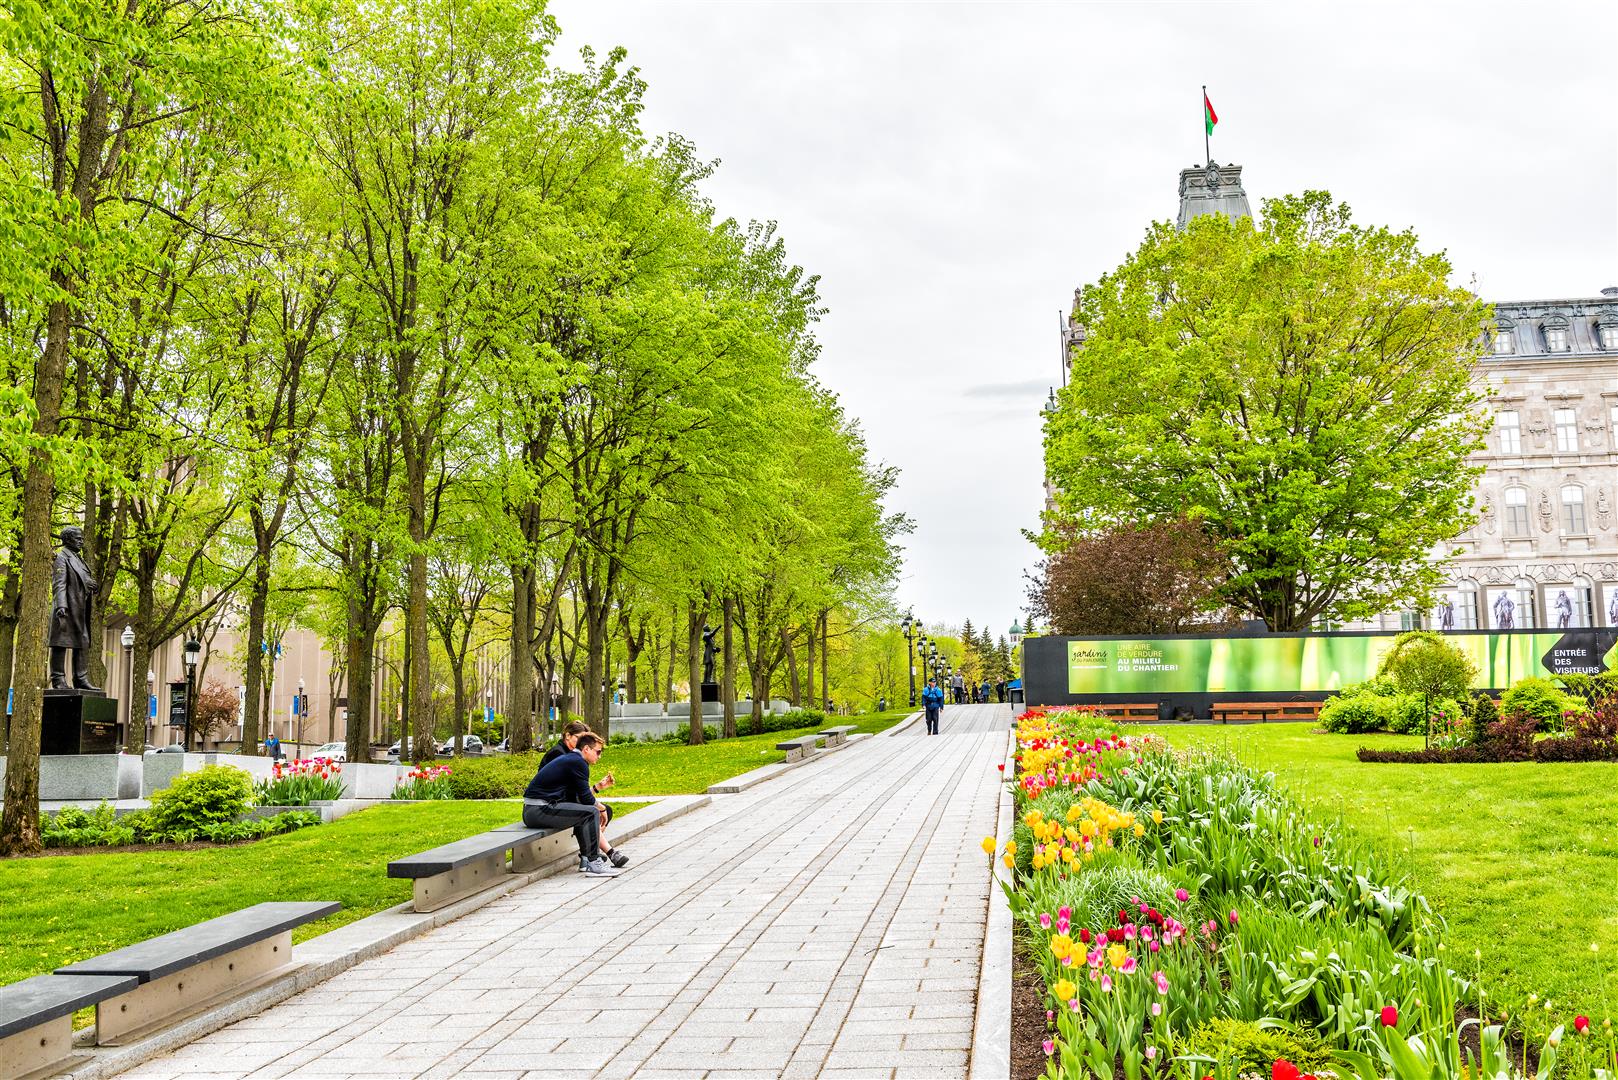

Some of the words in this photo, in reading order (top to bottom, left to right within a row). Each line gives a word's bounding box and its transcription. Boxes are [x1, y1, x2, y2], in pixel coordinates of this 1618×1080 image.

[1554, 648, 1586, 656] ENTRÉE
[1554, 658, 1572, 666] DES
[1555, 666, 1600, 674] VISITEURS
